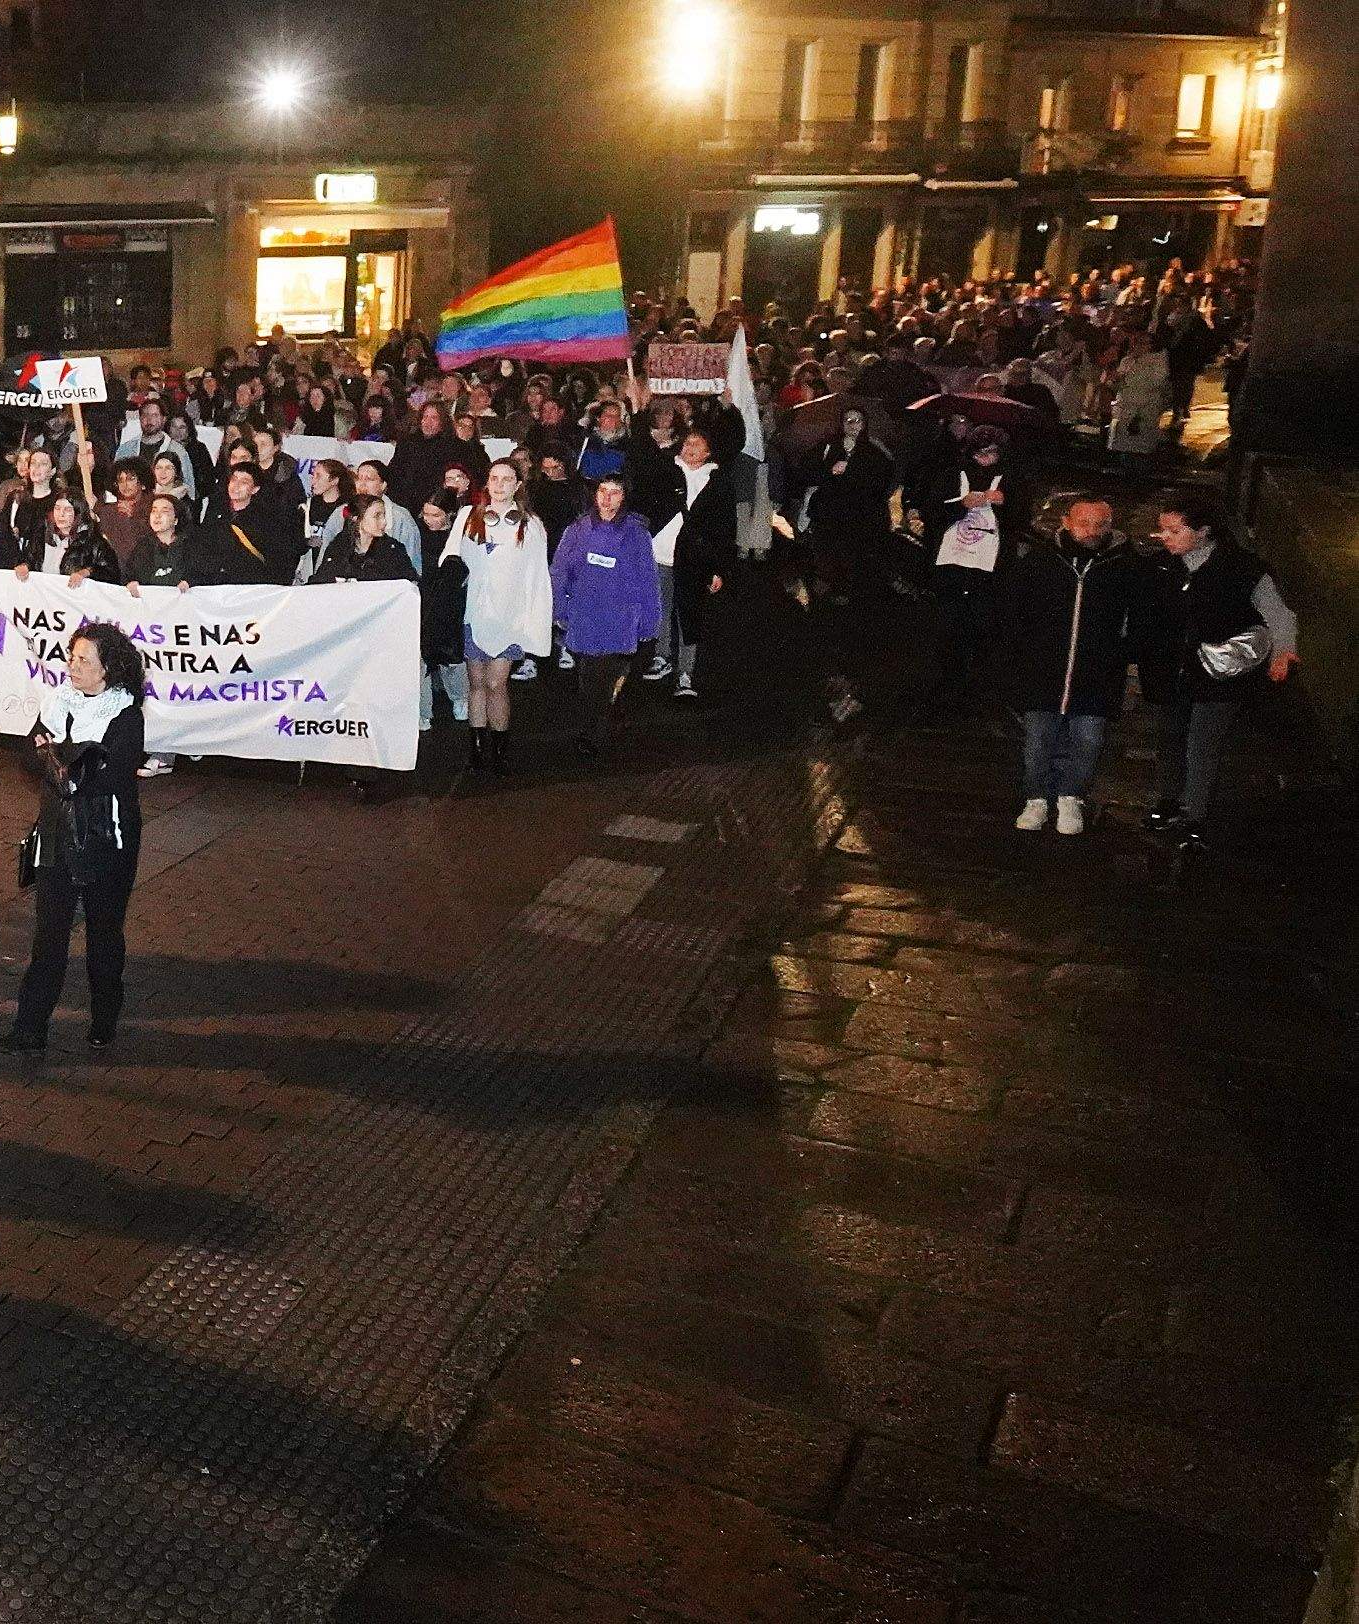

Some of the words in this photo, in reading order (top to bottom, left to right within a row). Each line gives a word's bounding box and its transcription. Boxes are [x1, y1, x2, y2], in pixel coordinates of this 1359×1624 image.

[47, 387, 98, 400] ERGUER
[13, 606, 66, 632] NAS
[174, 625, 190, 645] E
[200, 623, 260, 645] NAS
[230, 654, 254, 674] A
[163, 679, 328, 702] MACHISTA
